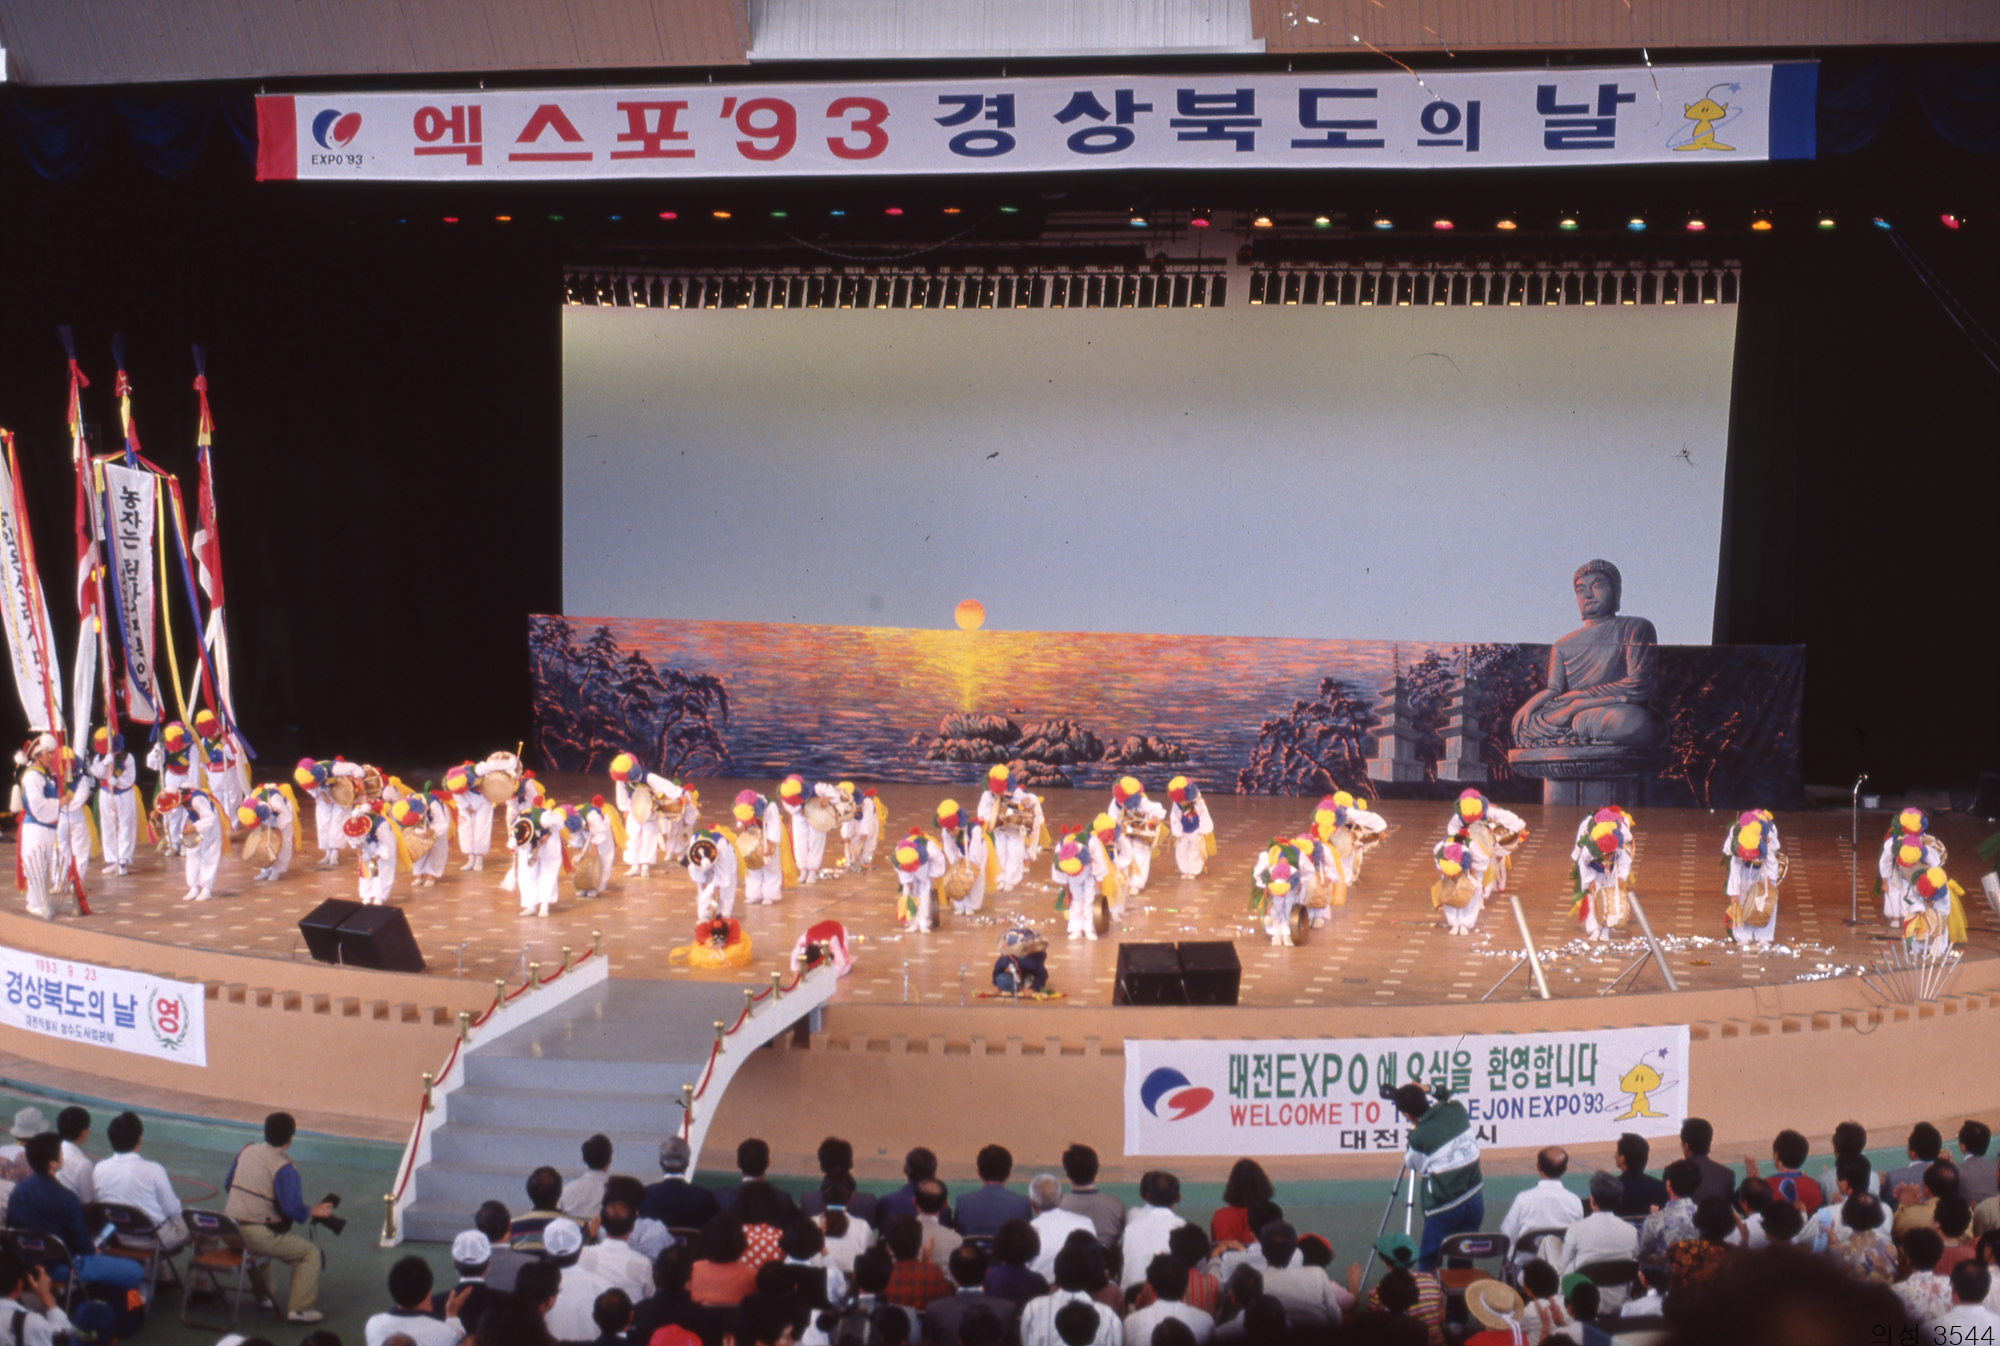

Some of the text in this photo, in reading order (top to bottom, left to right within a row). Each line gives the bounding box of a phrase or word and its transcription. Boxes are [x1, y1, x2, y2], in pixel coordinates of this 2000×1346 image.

[933, 88, 1481, 158] 경상북도의
[1536, 83, 1636, 150] 날
[6, 970, 138, 1029] 경상북도의 날
[157, 997, 180, 1034] 영
[1487, 1043, 1598, 1091] 환영합니다
[1230, 1103, 1342, 1126] WELCOME
[1351, 1101, 1380, 1124] TO
[1468, 1097, 1523, 1121] EJON
